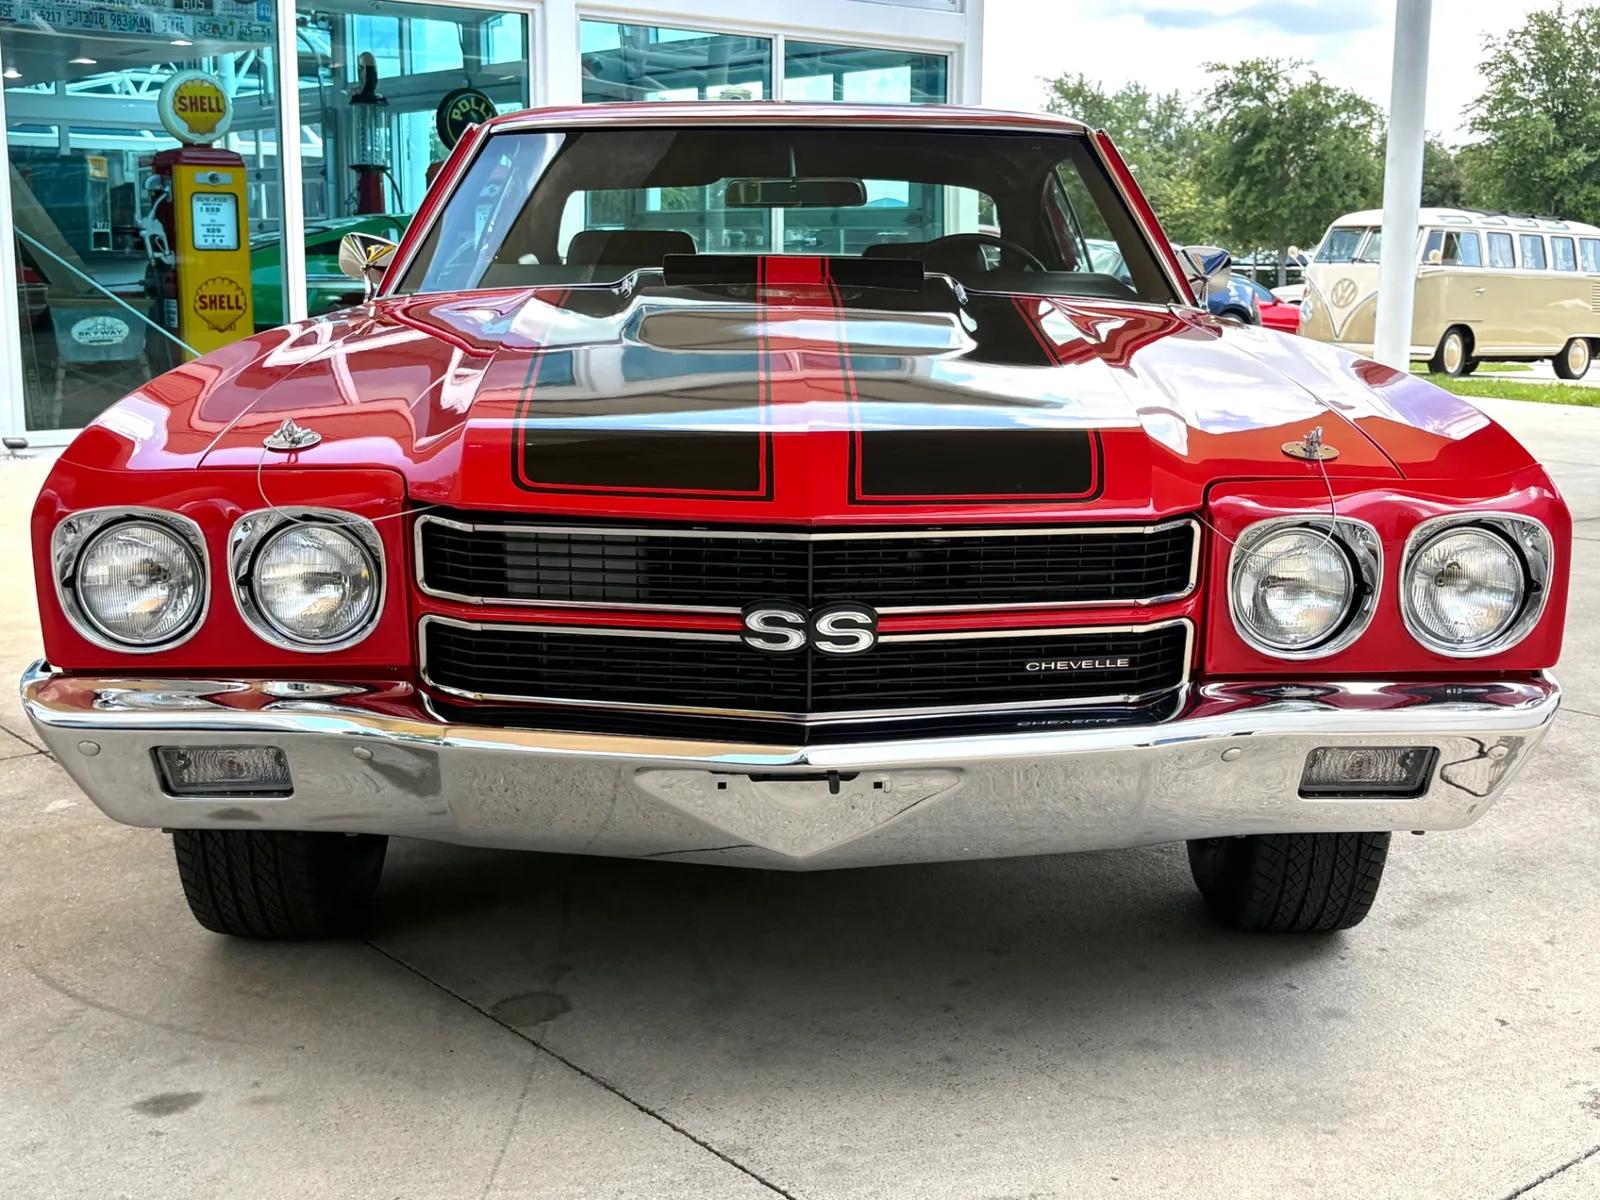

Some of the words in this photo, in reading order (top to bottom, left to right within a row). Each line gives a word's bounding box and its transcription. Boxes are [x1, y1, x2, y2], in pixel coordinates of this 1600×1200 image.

[178, 96, 223, 112] SHELL
[199, 295, 243, 310] SHELL
[78, 329, 122, 338] SKYWAY
[744, 609, 874, 653] SS
[1025, 658, 1129, 671] CHEVELLE
